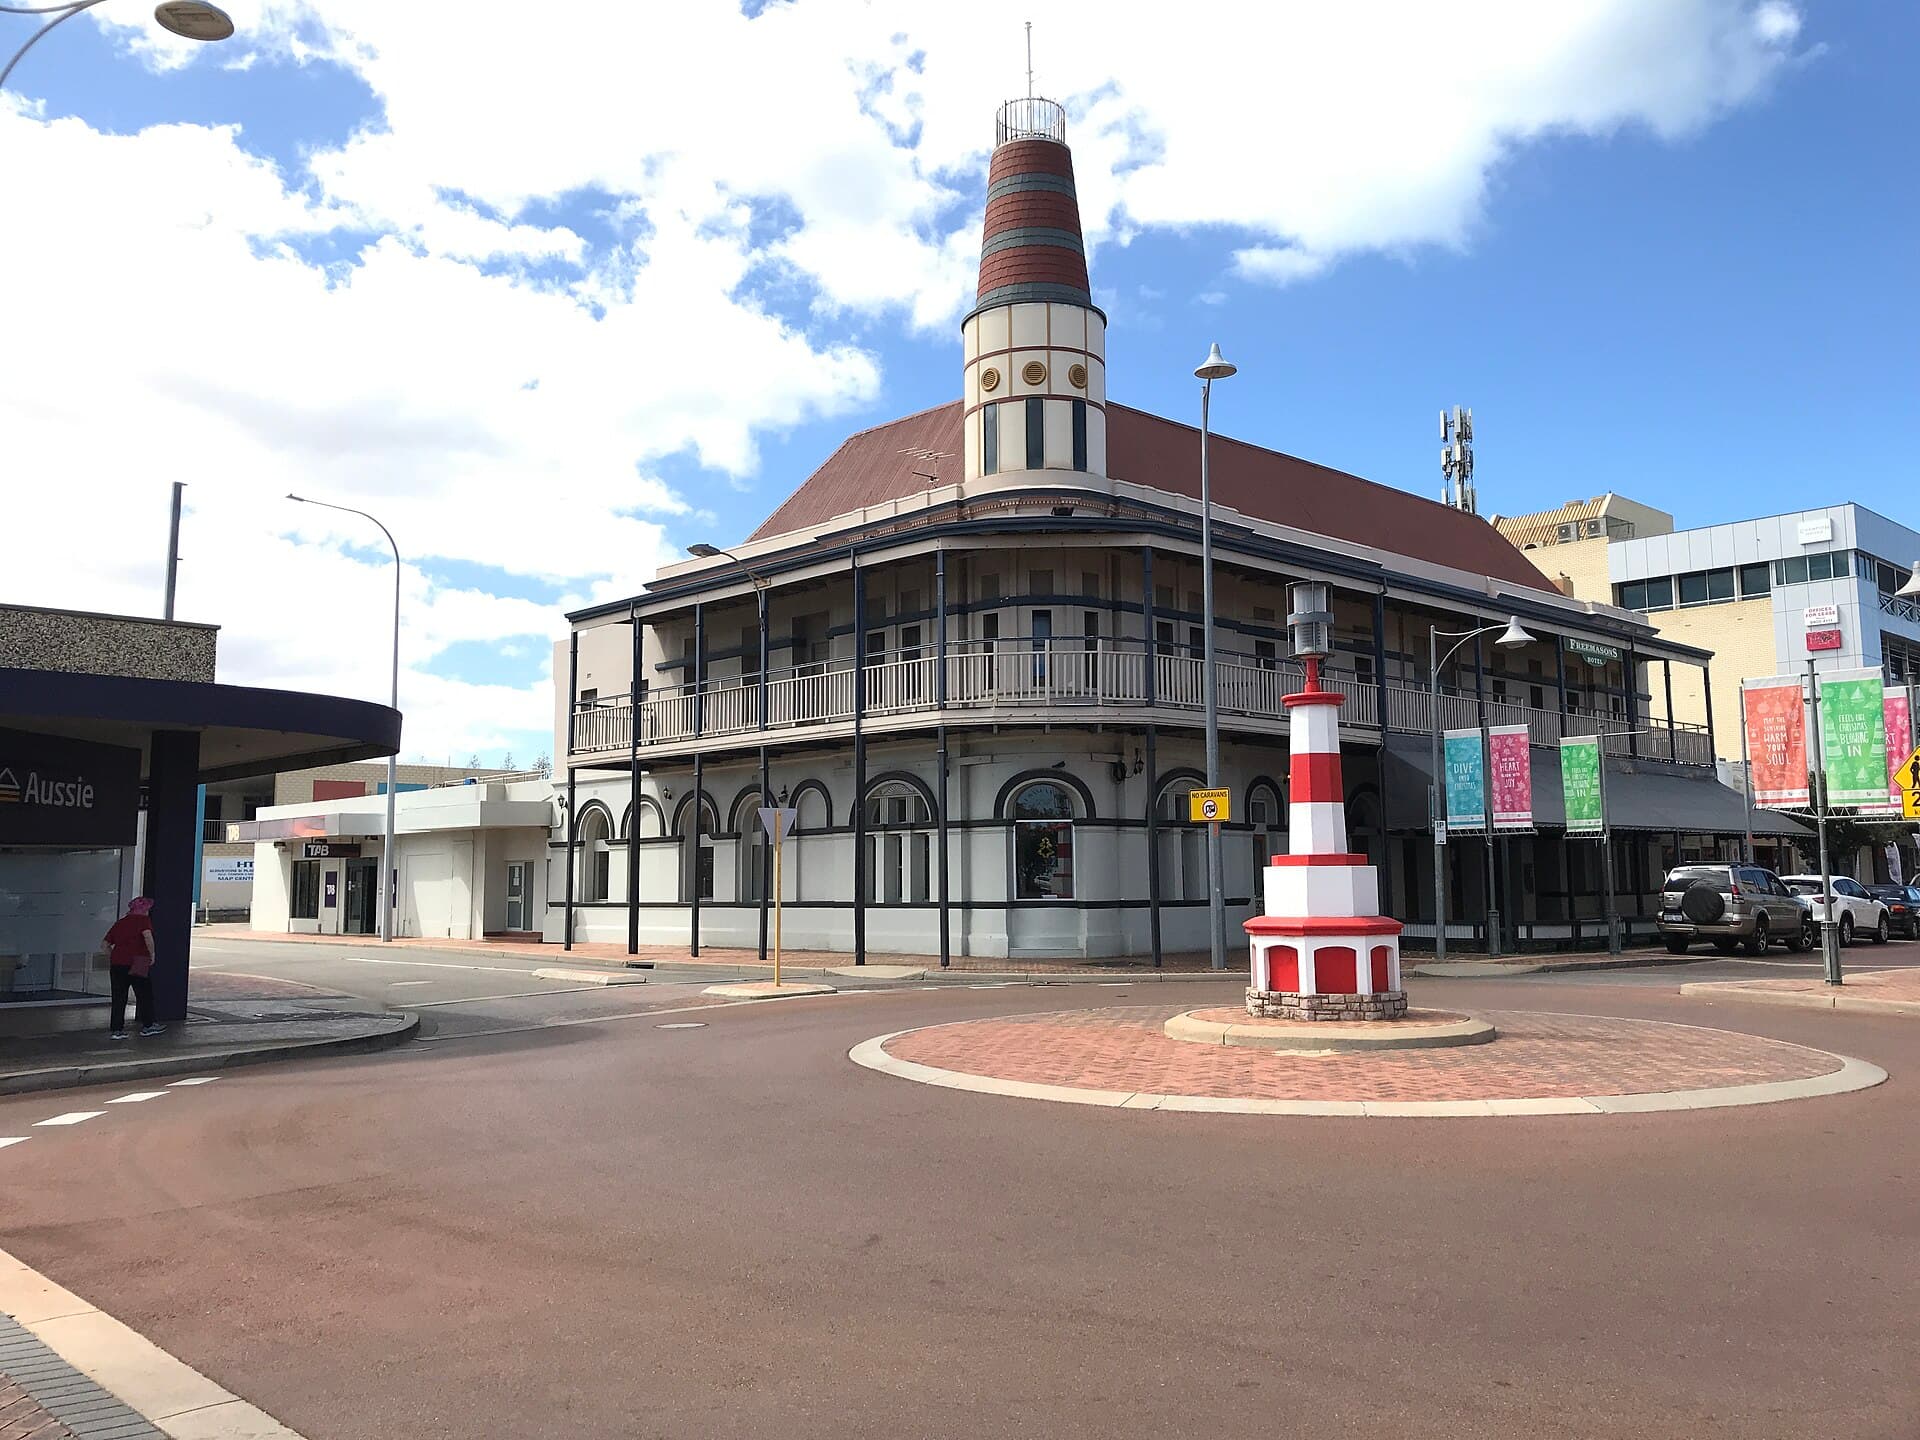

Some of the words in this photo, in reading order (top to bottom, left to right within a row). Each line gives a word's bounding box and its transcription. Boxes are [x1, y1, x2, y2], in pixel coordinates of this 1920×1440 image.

[1569, 638, 1618, 658] FREEMASONS
[1587, 656, 1603, 665] HOTEL
[1763, 731, 1789, 742] WARM
[1767, 743, 1787, 753] YOUR
[1847, 744, 1862, 757] IN
[1767, 752, 1791, 766] SOUL
[1453, 762, 1474, 774] DIVE
[1499, 761, 1520, 772] HEART
[1504, 778, 1515, 788] JOY
[24, 771, 94, 808] Aussie
[307, 845, 329, 857] TAB
